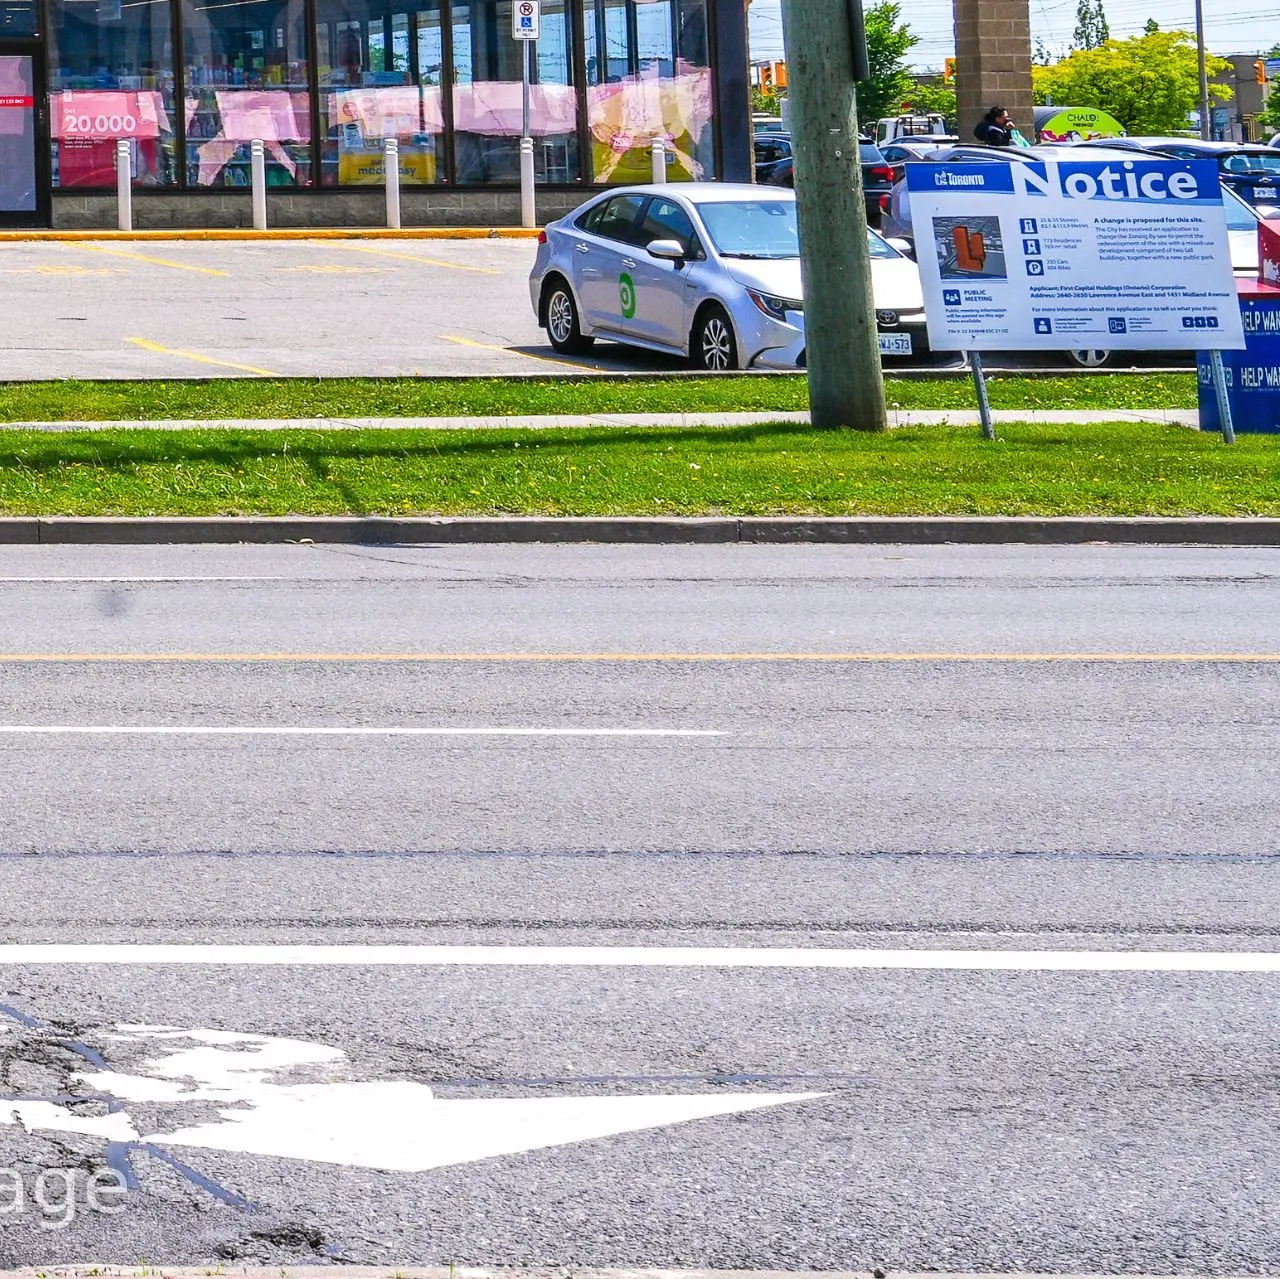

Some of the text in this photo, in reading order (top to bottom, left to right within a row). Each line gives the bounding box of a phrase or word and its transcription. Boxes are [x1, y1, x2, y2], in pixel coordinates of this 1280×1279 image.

[64, 115, 137, 134] 20,000
[946, 173, 985, 186] TORONTO
[1011, 160, 1199, 200] Notice
[1240, 368, 1264, 387] HELP
